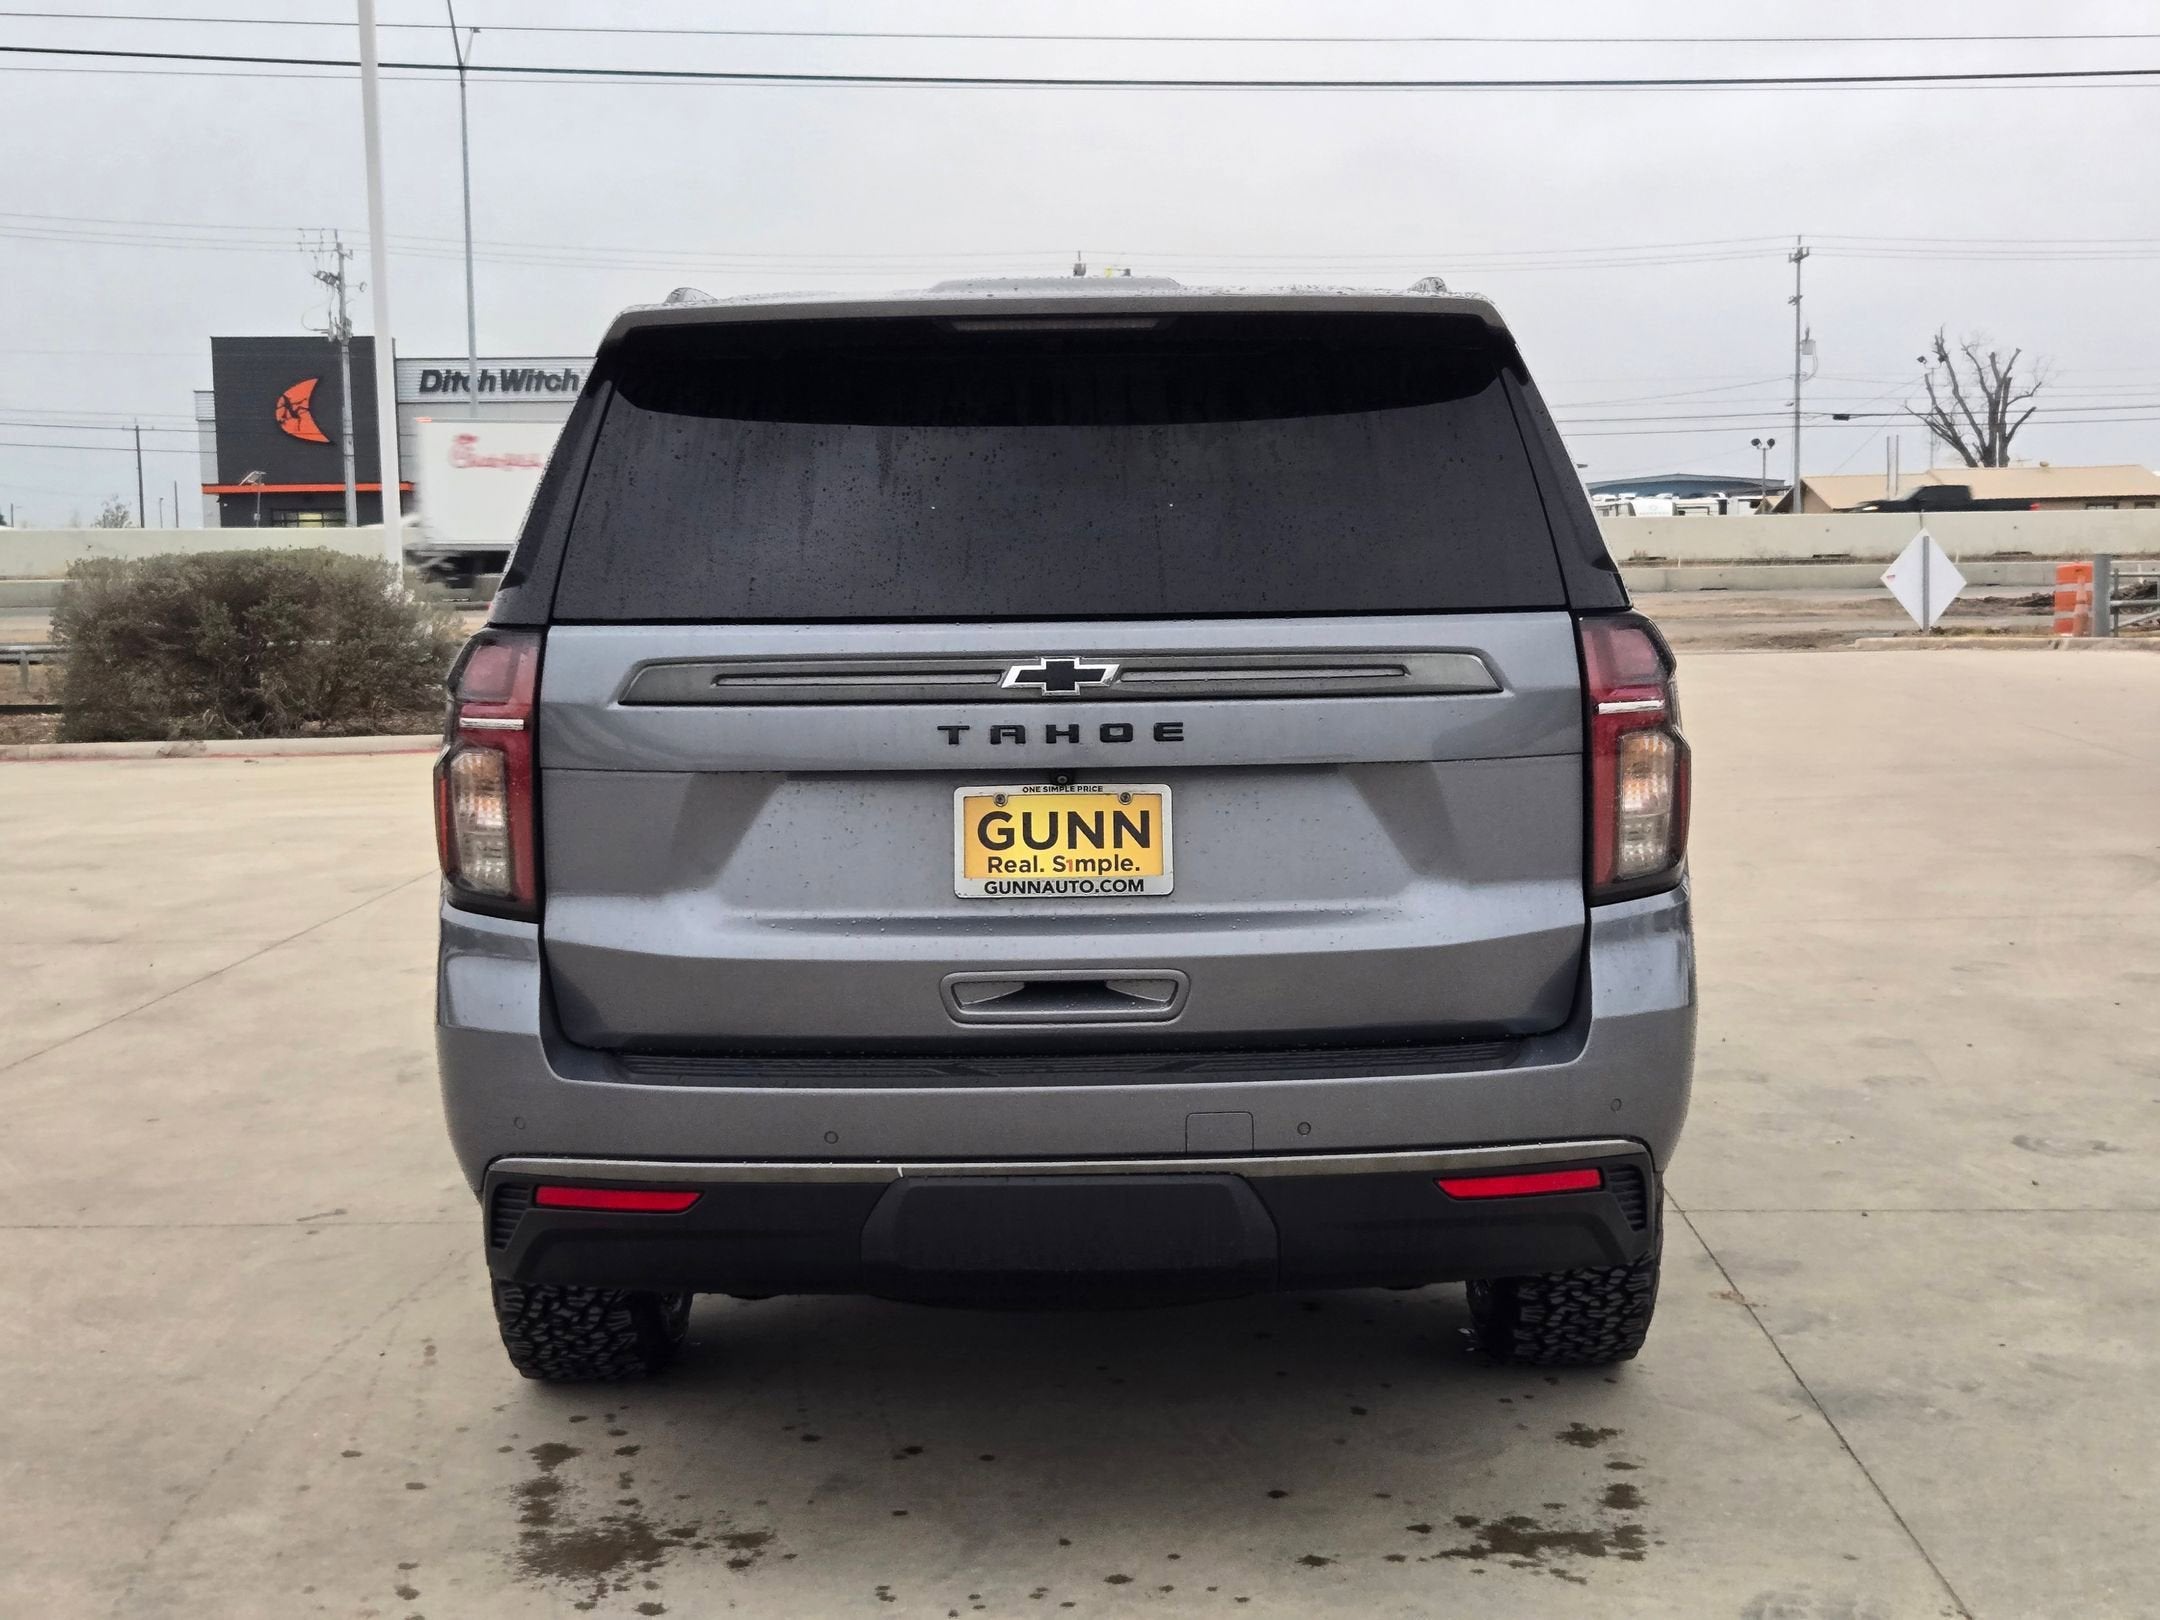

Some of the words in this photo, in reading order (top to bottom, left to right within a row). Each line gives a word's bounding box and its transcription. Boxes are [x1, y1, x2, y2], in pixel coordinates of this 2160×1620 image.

[501, 368, 580, 392] Witch
[937, 721, 1185, 745] TAHOE
[1022, 785, 1041, 794] ONE
[1042, 785, 1076, 793] SIMPLE
[1077, 785, 1104, 793] PRICE
[977, 810, 1151, 850] GUNN
[987, 855, 1045, 874] Real.
[984, 878, 1145, 895] GUNNAUTO.COM
